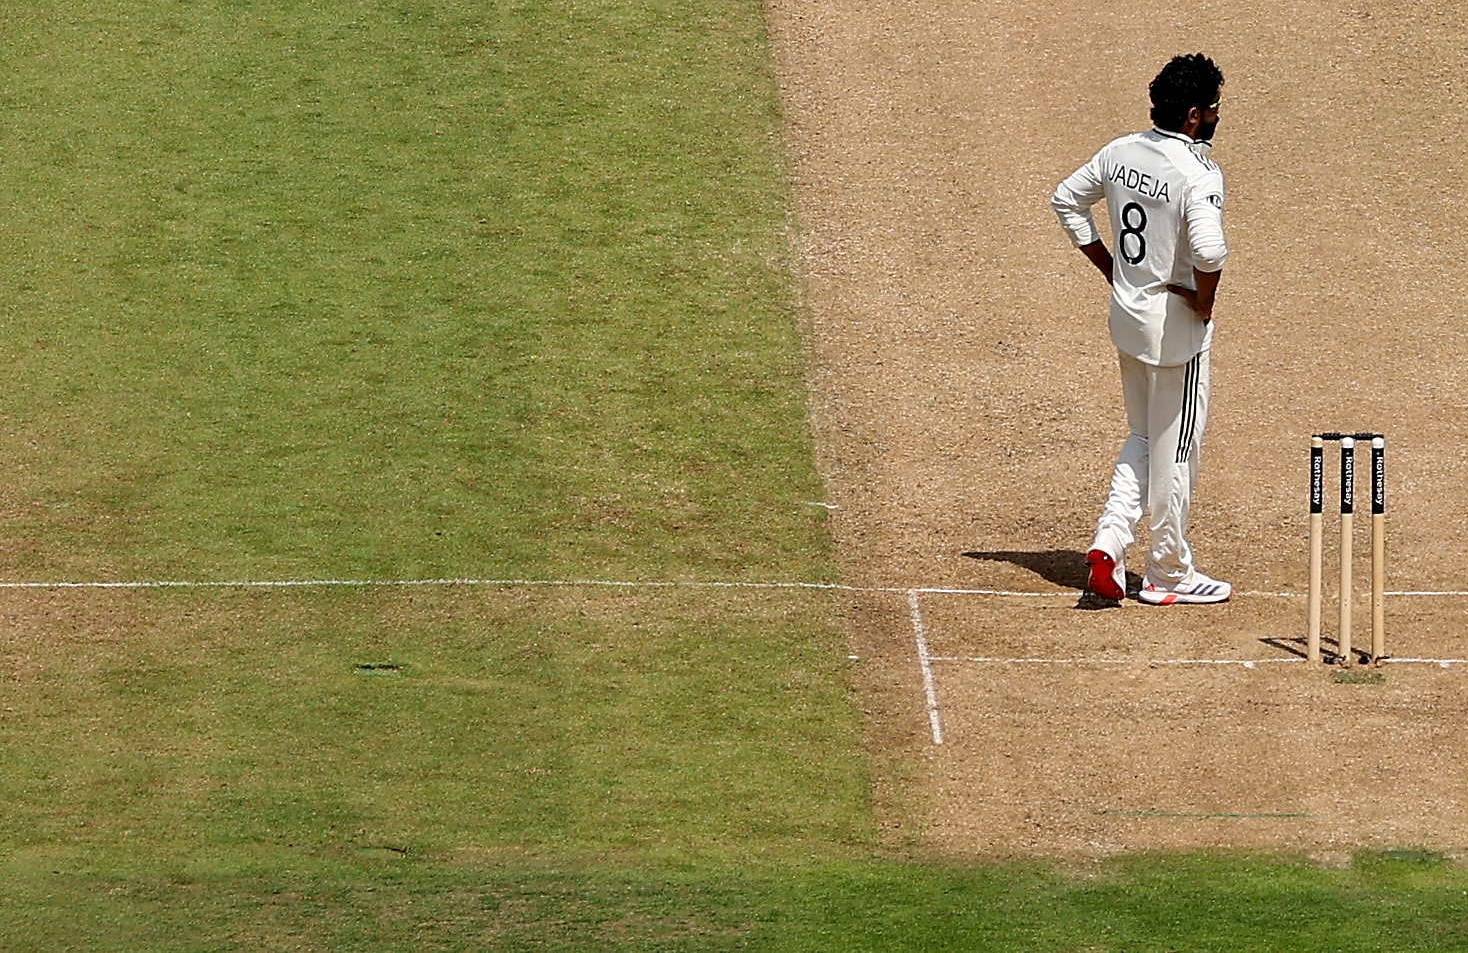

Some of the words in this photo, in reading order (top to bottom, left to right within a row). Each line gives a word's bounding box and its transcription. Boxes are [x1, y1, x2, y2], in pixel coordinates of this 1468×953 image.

[1108, 162, 1170, 203] JADEJA
[1119, 201, 1147, 265] 8
[1312, 455, 1322, 505] Rothesay
[1344, 456, 1352, 505] Rothesay
[1375, 456, 1383, 505] Rothesay
